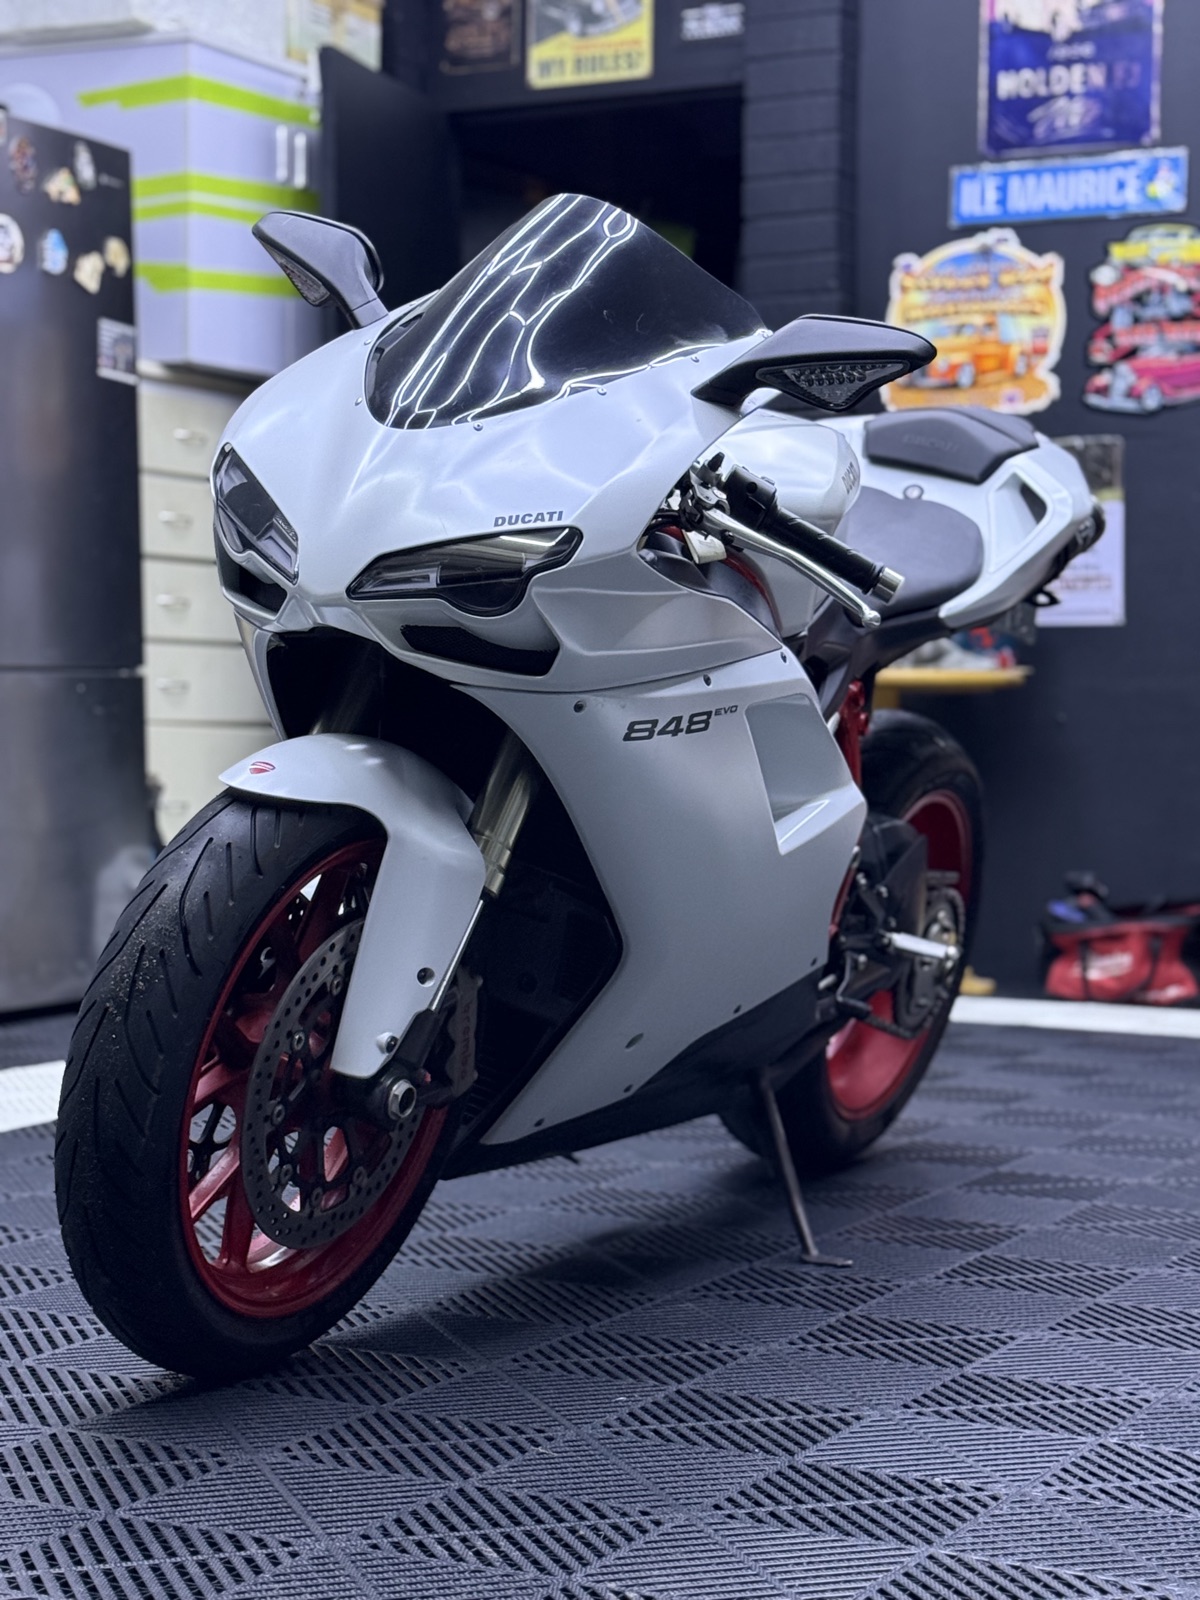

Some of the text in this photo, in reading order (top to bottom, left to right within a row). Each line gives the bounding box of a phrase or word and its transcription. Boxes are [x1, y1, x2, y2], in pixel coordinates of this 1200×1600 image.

[997, 63, 1106, 100] HOLDEN
[1006, 164, 1141, 214] MAURICE
[493, 510, 564, 528] DUCATI
[622, 704, 738, 742] 848 EVO
